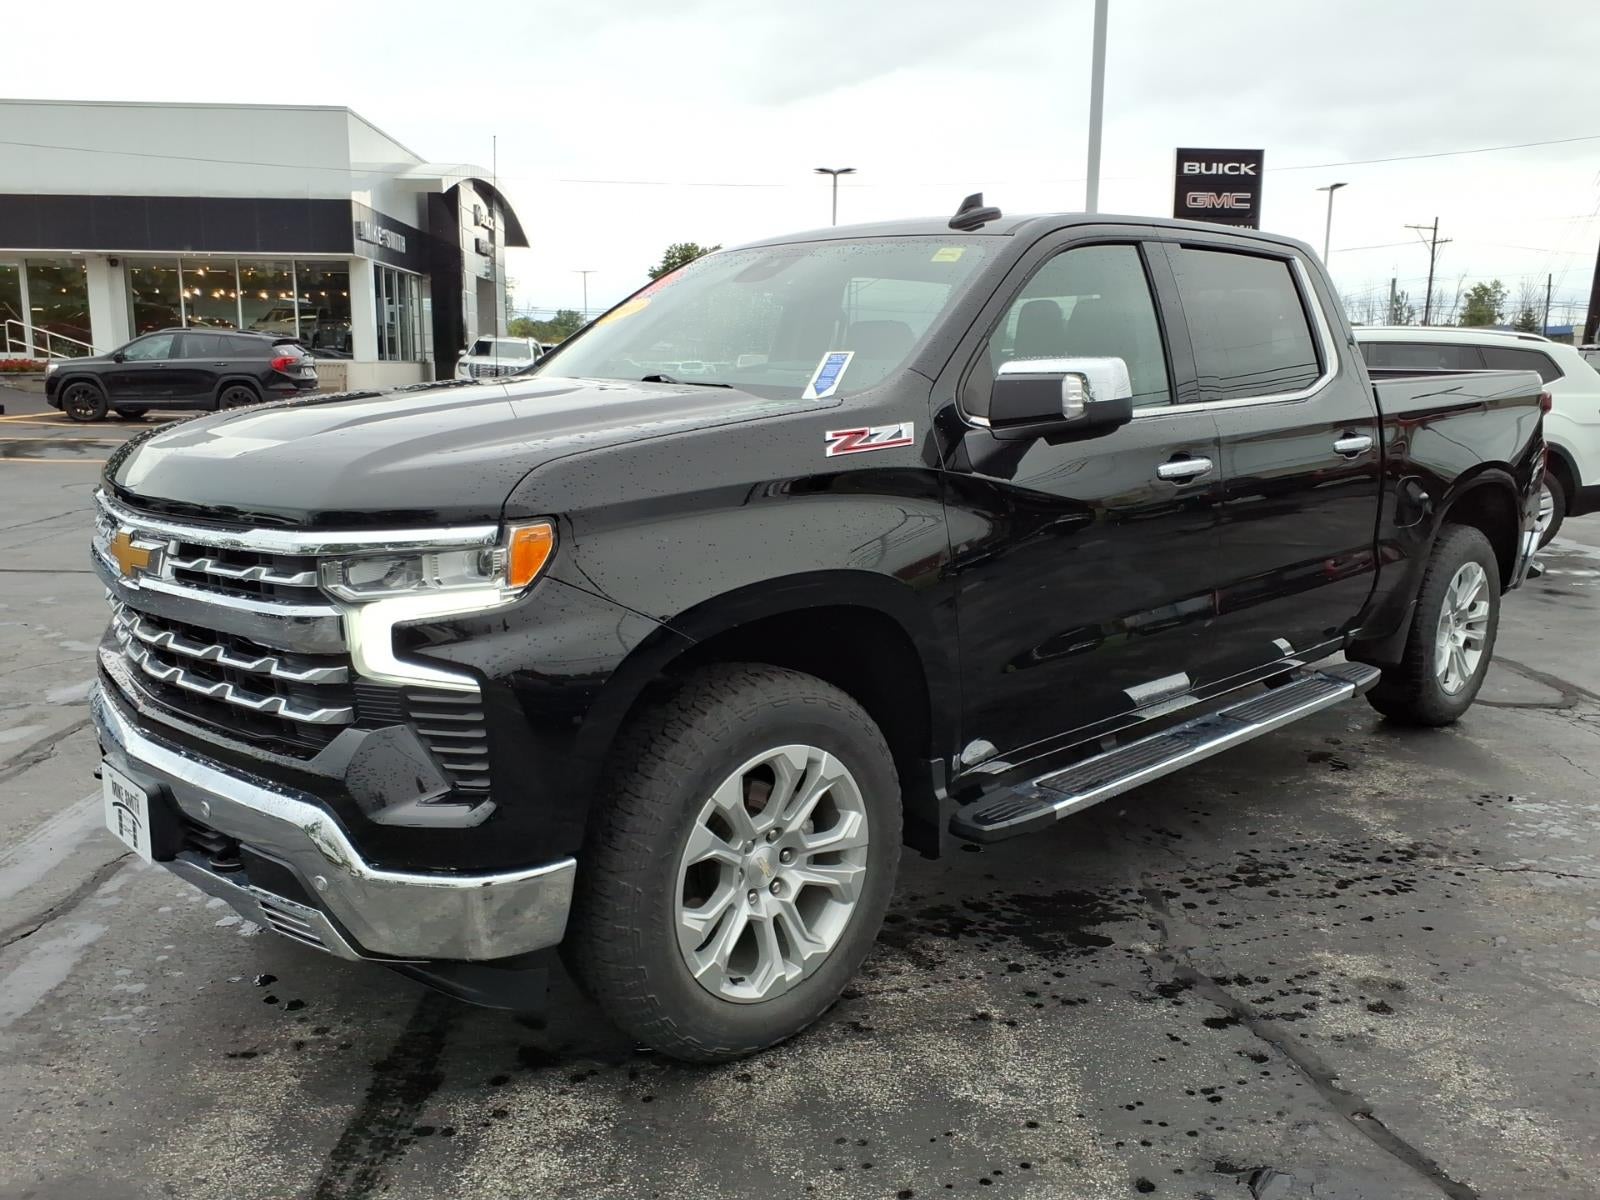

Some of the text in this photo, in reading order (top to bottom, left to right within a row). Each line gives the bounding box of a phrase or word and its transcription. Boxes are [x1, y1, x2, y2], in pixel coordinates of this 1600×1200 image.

[1183, 162, 1257, 175] BUICK
[1186, 192, 1252, 209] GMC
[824, 421, 914, 458] Z71
